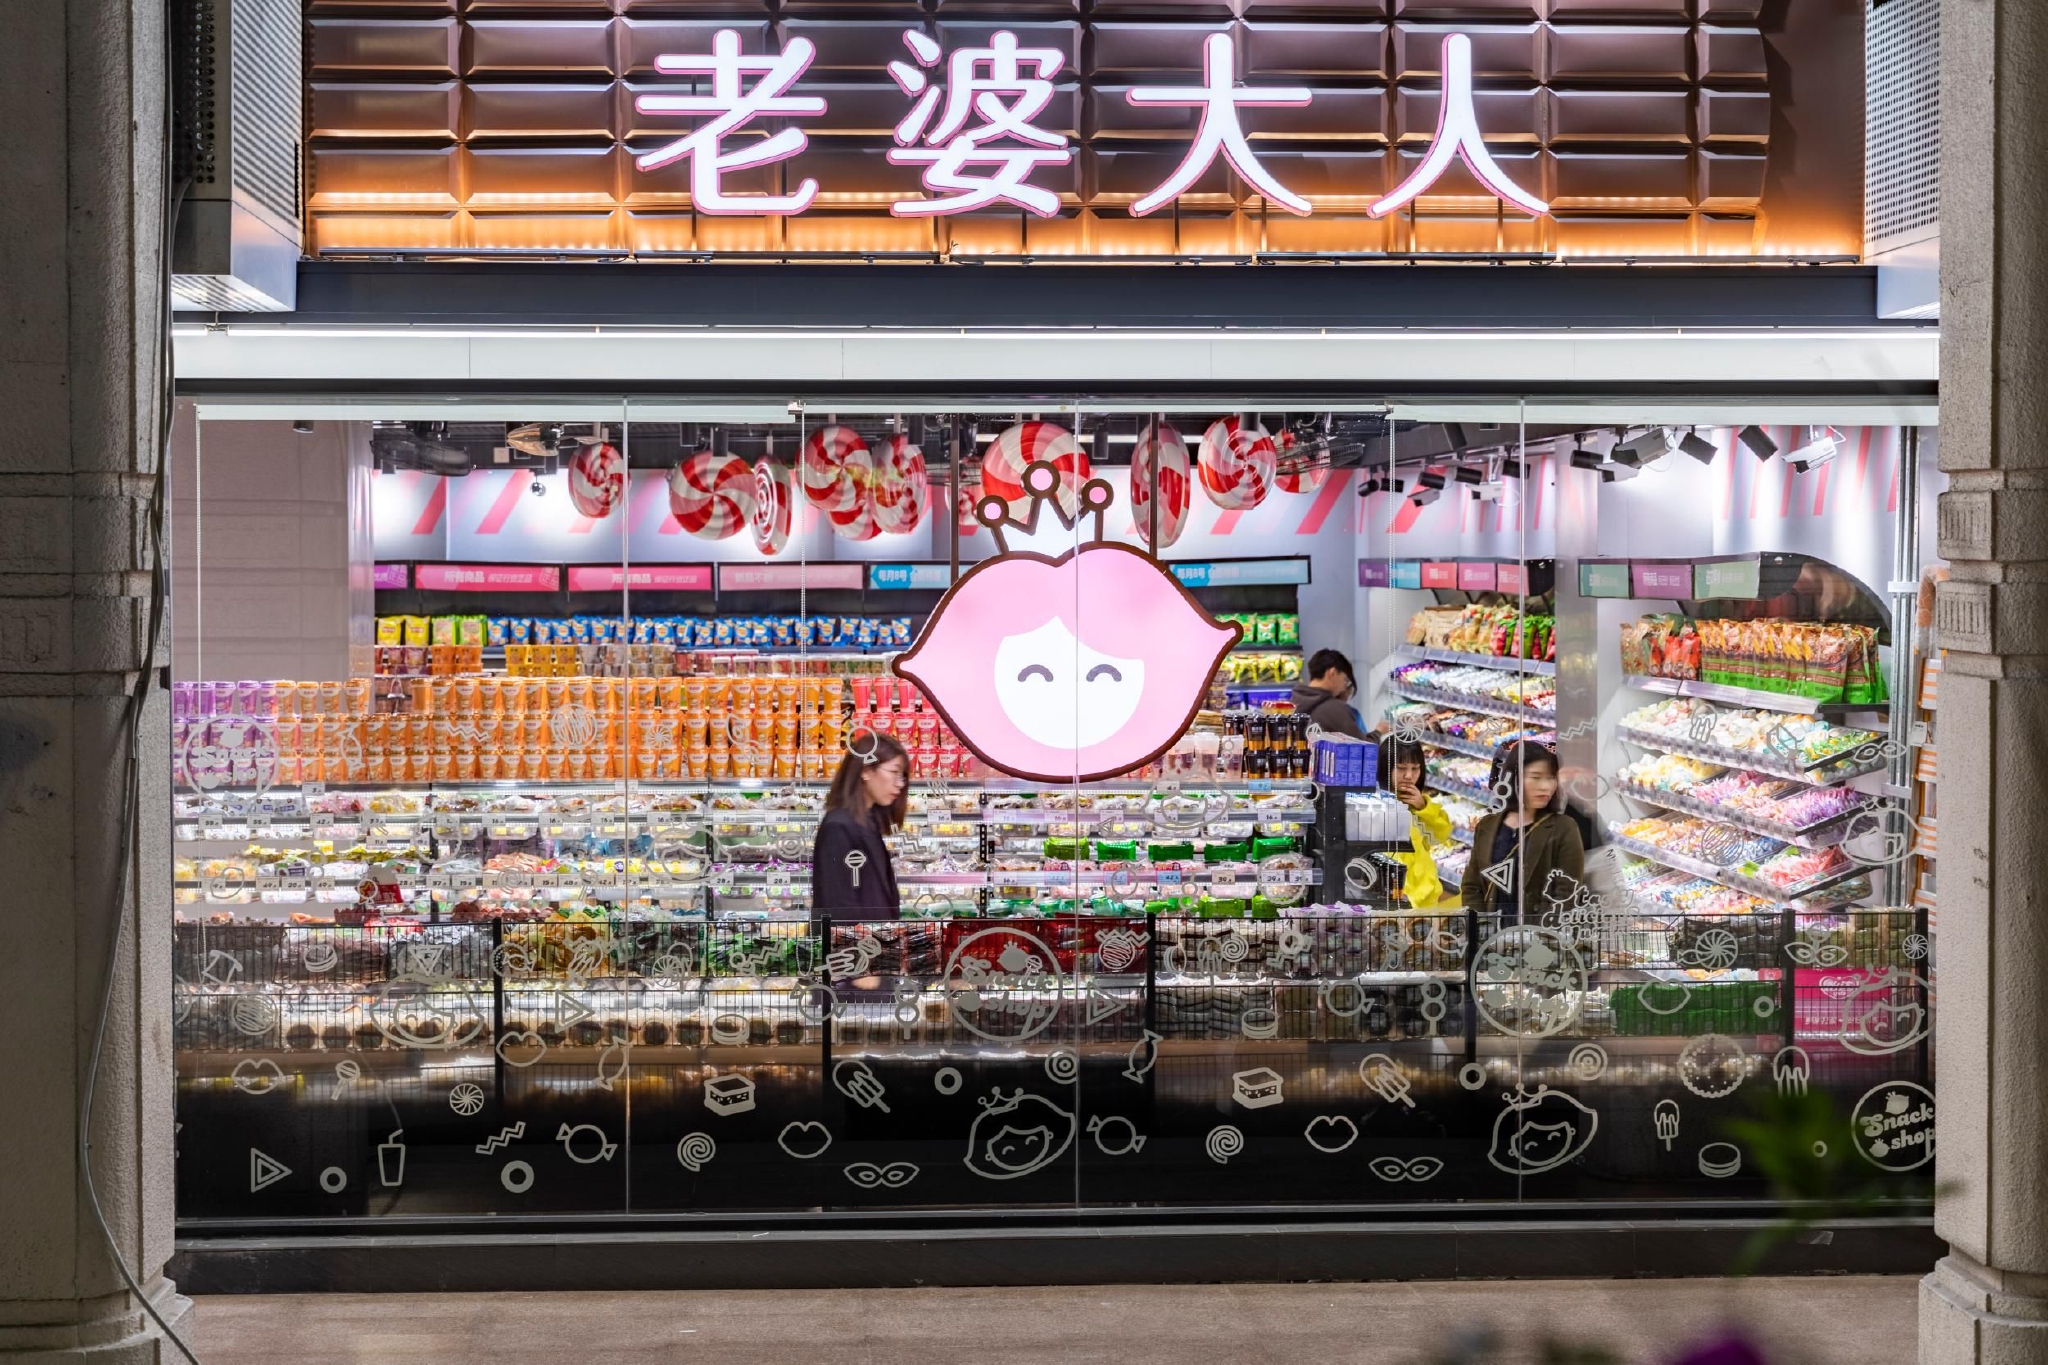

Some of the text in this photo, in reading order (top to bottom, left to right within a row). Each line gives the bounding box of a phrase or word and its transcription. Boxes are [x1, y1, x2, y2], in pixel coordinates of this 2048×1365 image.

[635, 28, 1551, 219] 老婆大人
[191, 739, 275, 768] Snack
[221, 760, 270, 796] shop
[1574, 886, 1634, 908] tasy
[961, 956, 1054, 993] Snack
[1487, 952, 1578, 991] Snack
[987, 991, 1047, 1037] shop
[1511, 990, 1570, 1033] shop
[1860, 1103, 1935, 1137] Snack
